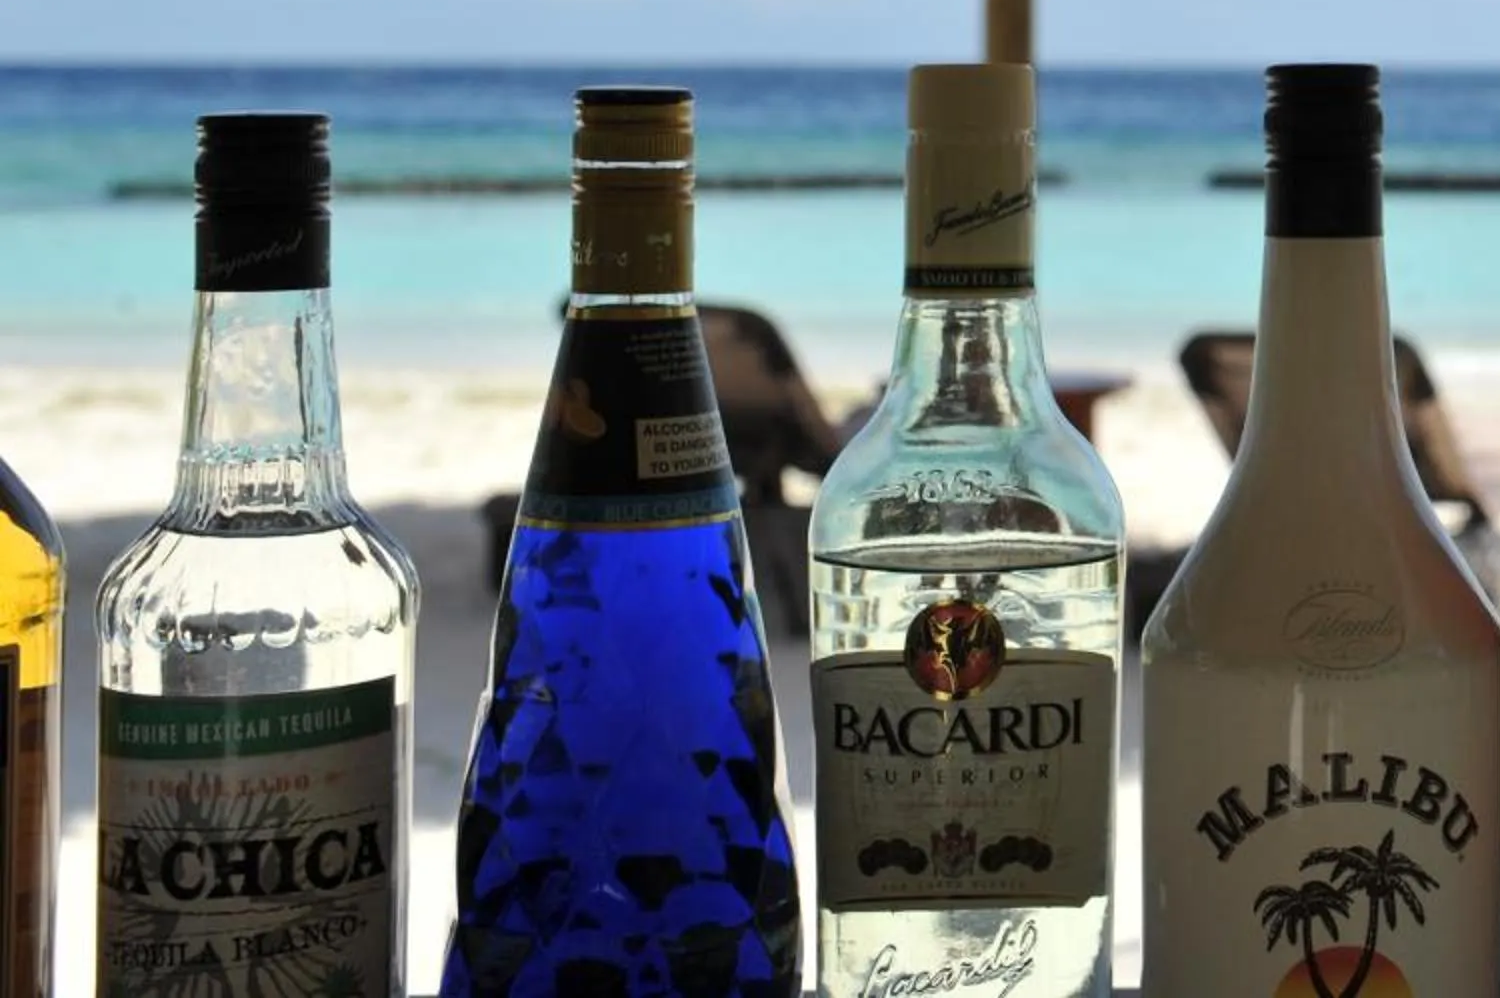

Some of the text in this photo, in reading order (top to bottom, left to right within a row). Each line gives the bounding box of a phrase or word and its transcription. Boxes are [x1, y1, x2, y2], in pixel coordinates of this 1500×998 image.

[184, 717, 271, 744] MEXICAN
[278, 706, 354, 736] TEQUILA
[833, 697, 1086, 758] BACARDI
[863, 762, 1051, 788] SUPERIOR
[1194, 750, 1481, 864] MALIBU
[160, 822, 387, 901] CHICA
